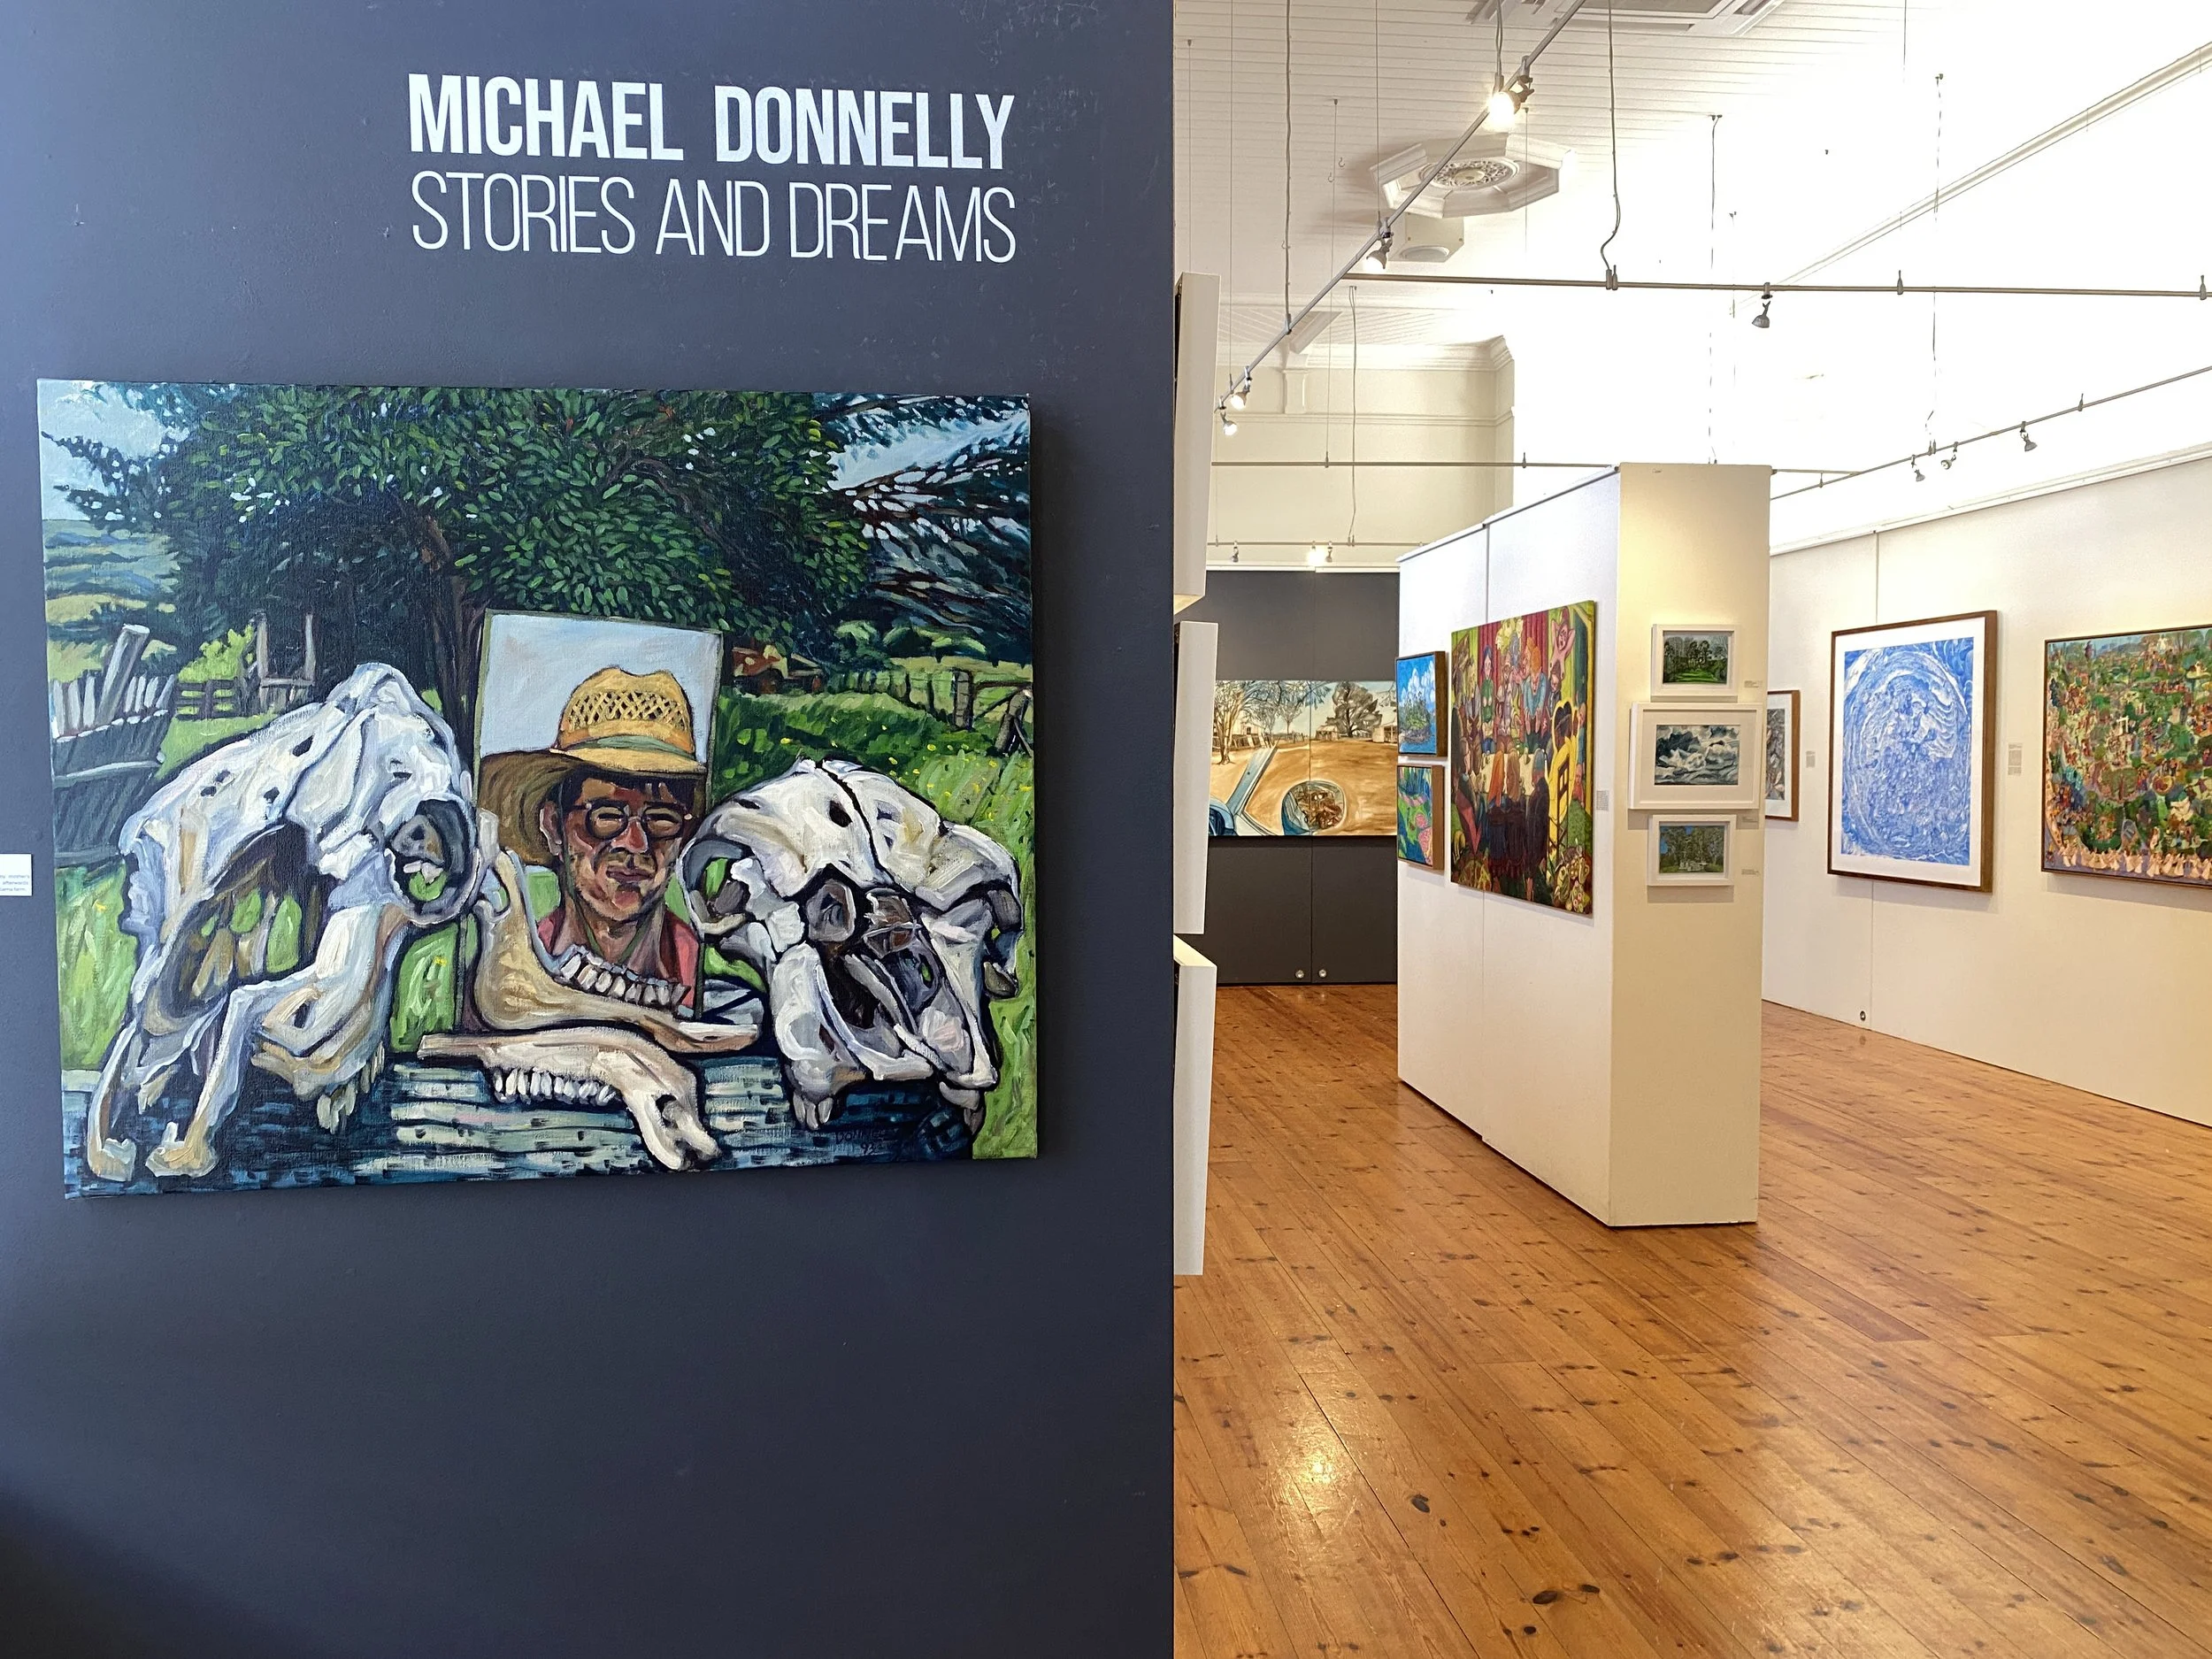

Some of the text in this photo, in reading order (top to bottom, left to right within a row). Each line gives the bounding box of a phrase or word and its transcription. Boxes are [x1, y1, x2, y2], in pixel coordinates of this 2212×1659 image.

[408, 73, 1016, 171] MICHAEL DONNELLY
[411, 170, 1018, 264] STORIES AND DREAMS
